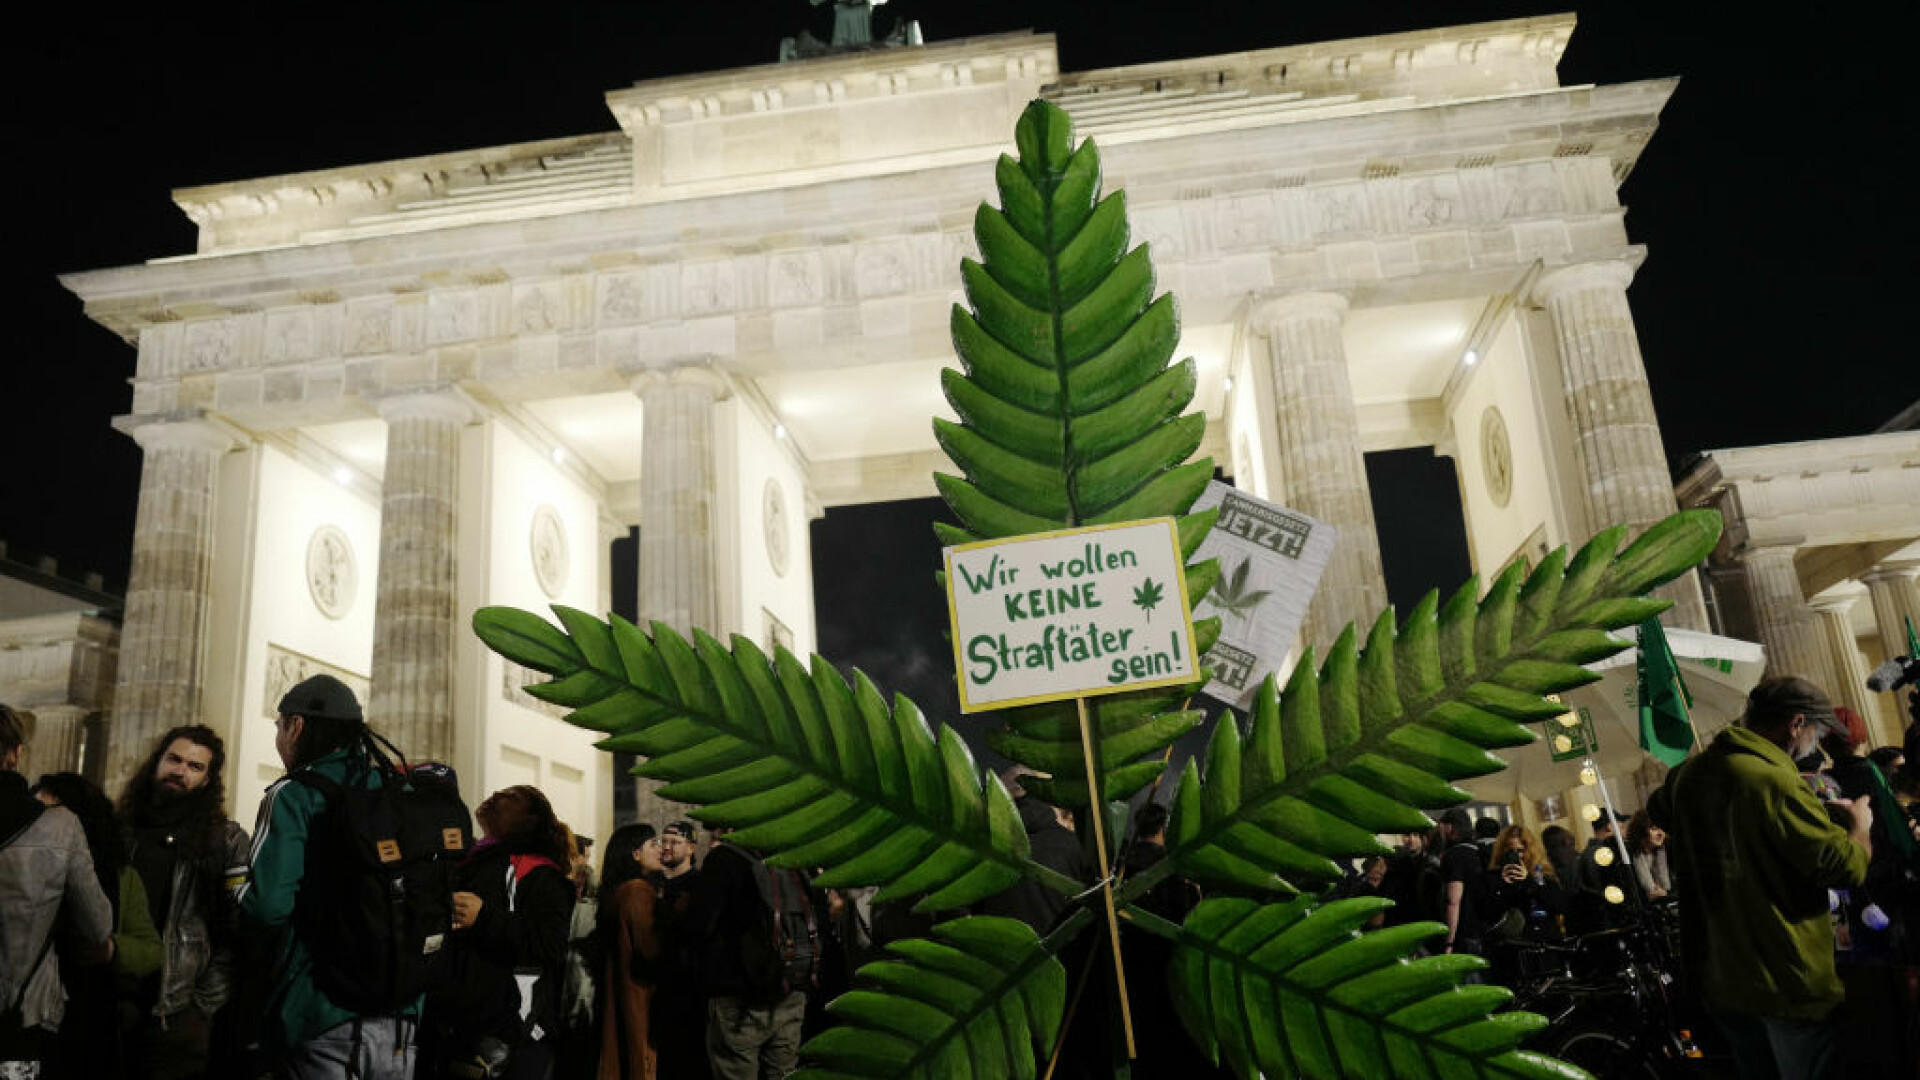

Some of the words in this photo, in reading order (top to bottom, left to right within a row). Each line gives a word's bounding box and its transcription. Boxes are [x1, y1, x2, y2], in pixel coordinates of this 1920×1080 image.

[1216, 508, 1302, 556] JETZT!
[958, 553, 1020, 594] Wir
[1040, 542, 1137, 579] wollen
[1005, 581, 1102, 622] KEINE
[967, 622, 1133, 685] Straftäter
[1107, 631, 1184, 684] sein!
